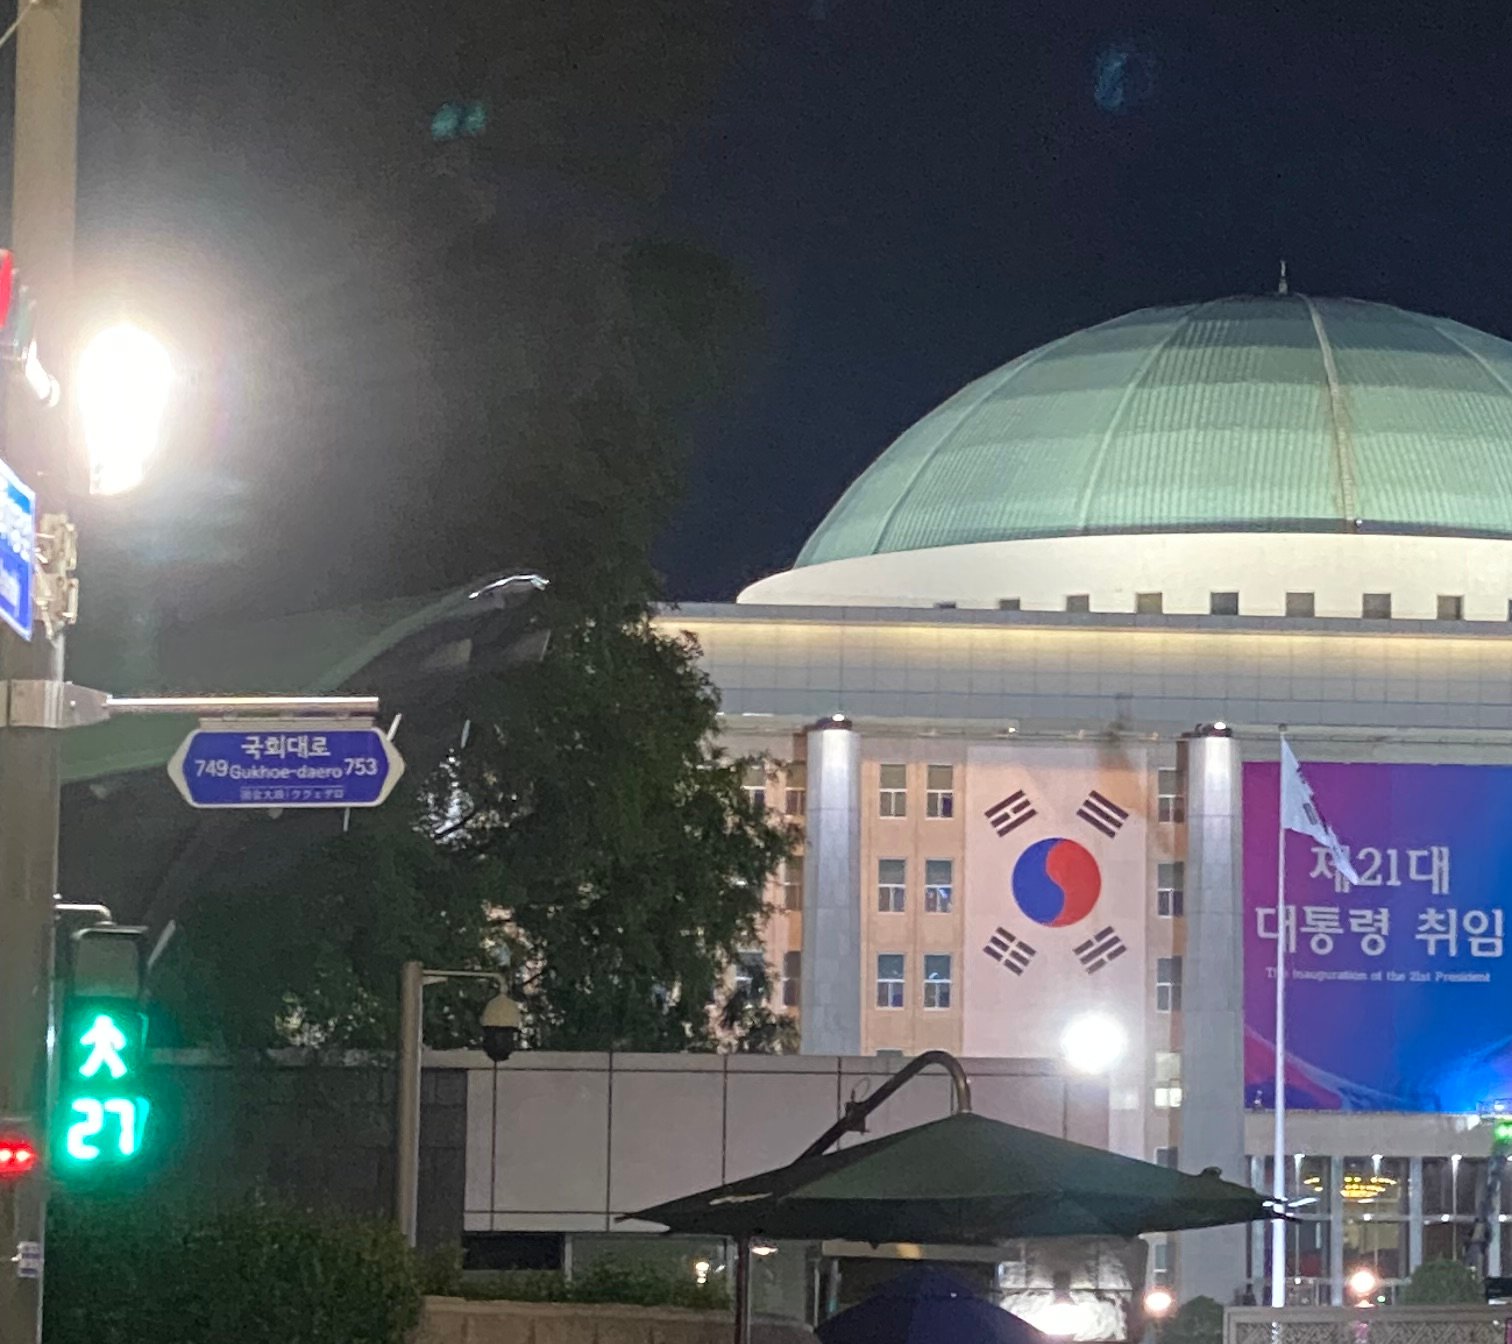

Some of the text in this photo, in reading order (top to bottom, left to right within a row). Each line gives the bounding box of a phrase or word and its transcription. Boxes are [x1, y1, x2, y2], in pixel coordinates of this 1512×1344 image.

[241, 736, 330, 759] 국회대로
[195, 758, 378, 779] 749 Gukhoe-daero 753
[1309, 846, 1450, 895] 제21대
[1255, 905, 1504, 958] 대통령 취임
[1370, 970, 1381, 981] of
[1386, 971, 1406, 981] the
[1435, 971, 1490, 983] President
[66, 1097, 137, 1160] 27
